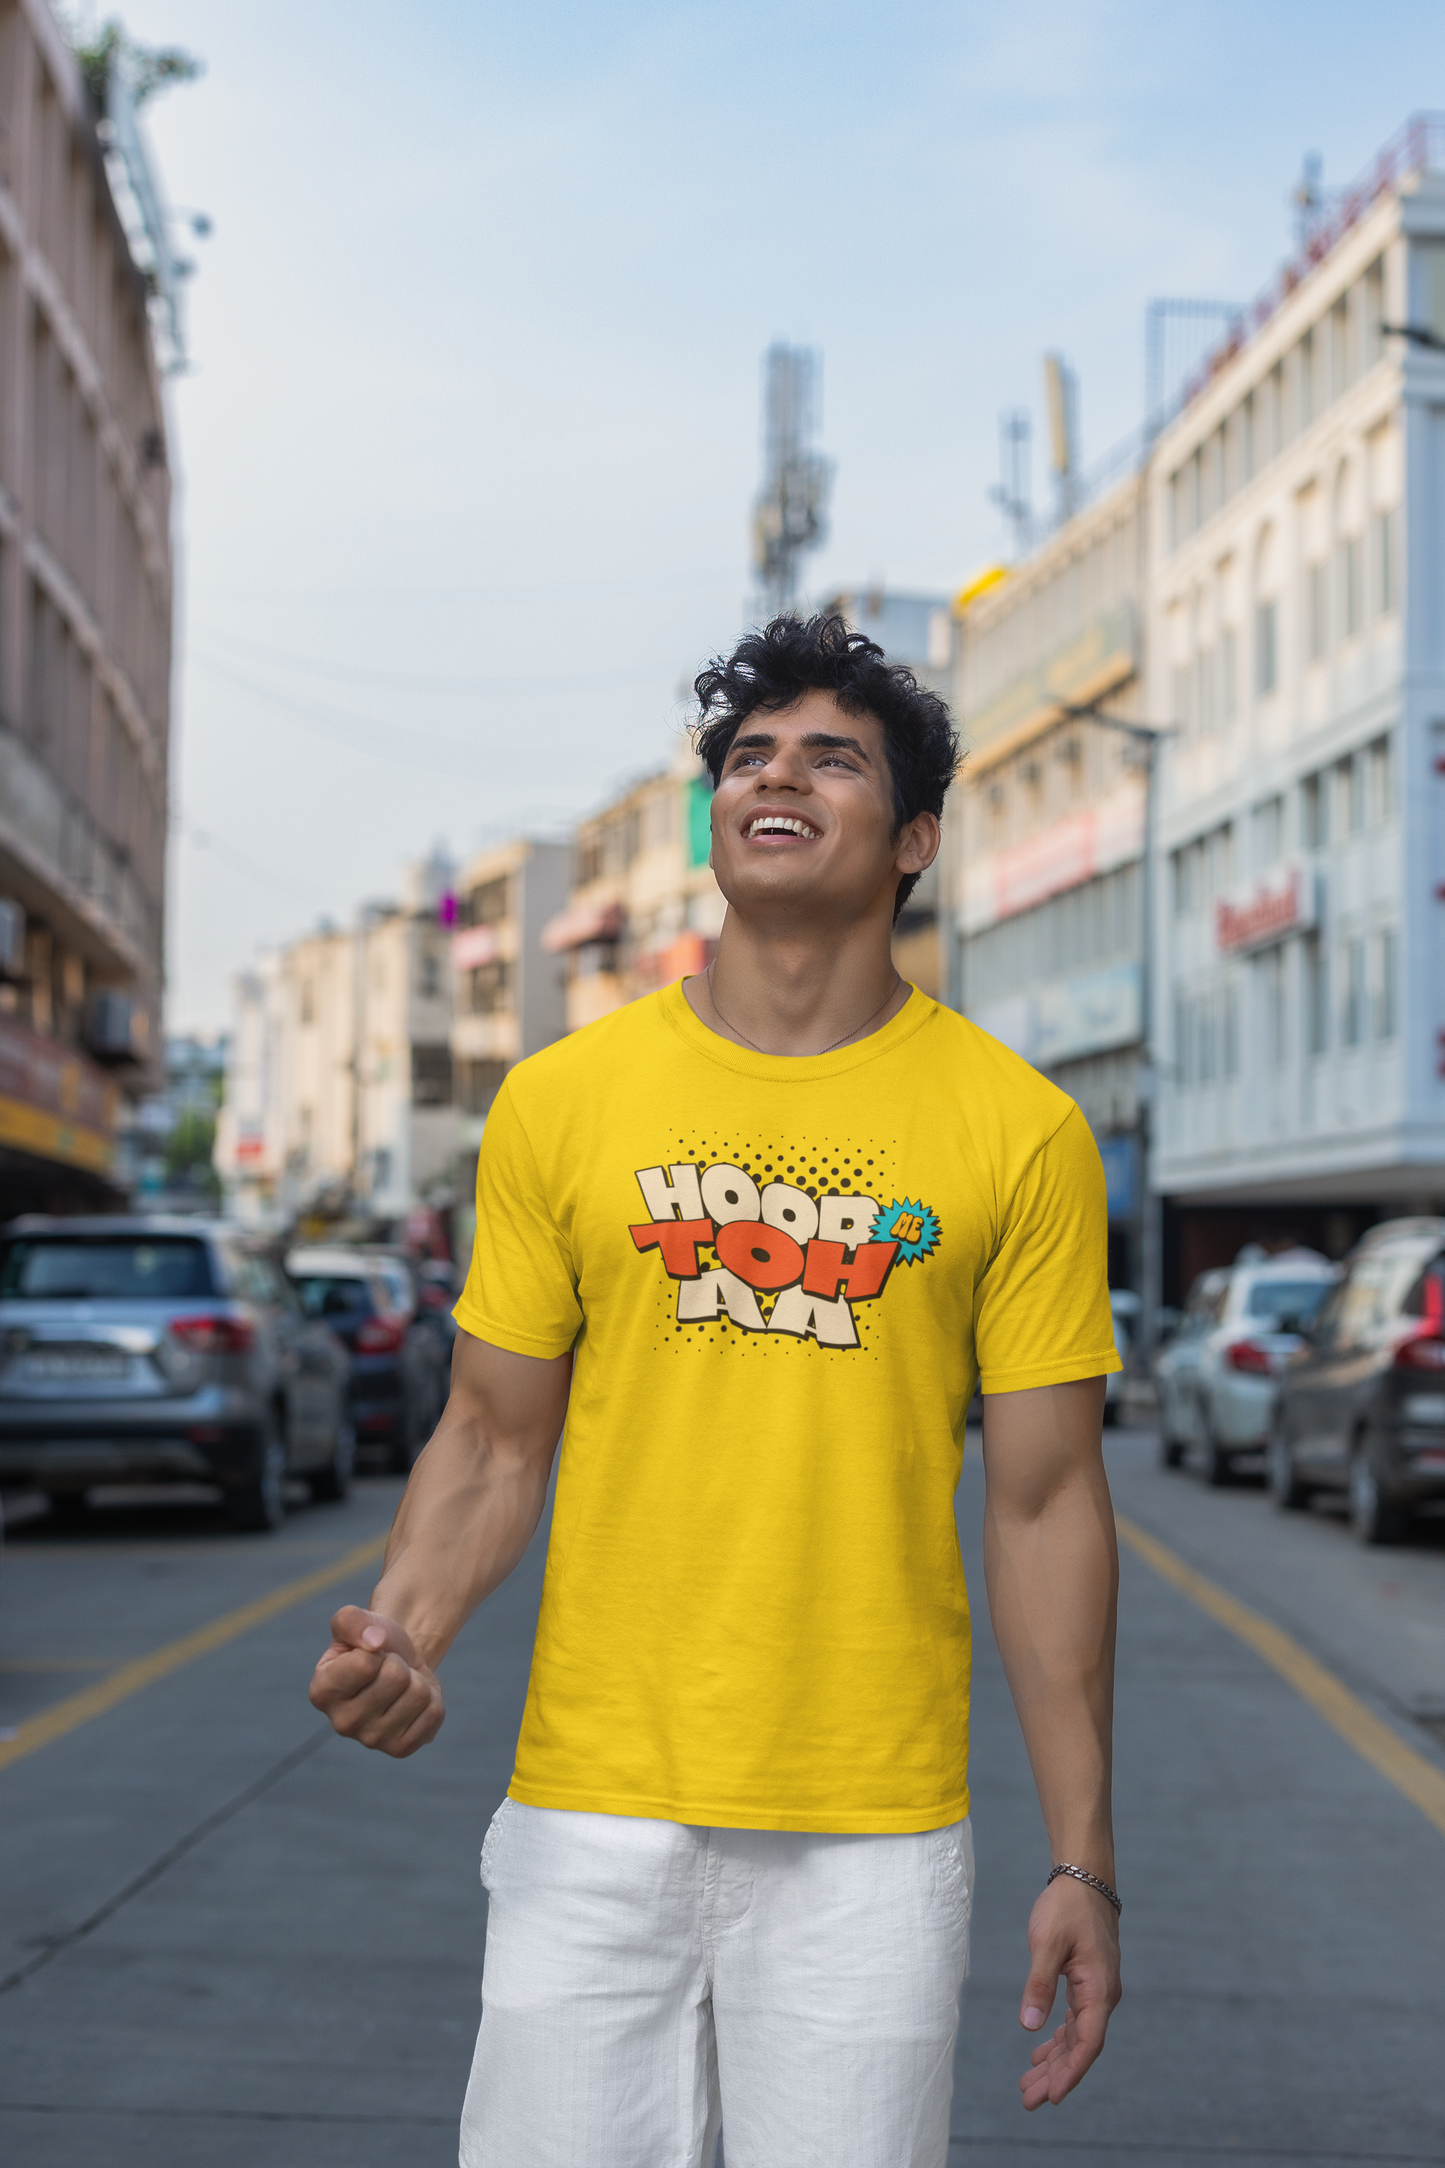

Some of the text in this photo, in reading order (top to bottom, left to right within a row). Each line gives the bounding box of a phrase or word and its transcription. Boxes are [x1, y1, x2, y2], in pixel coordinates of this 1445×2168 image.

[628, 1217, 901, 1303] TOH
[890, 1211, 924, 1246] ME
[676, 1267, 862, 1349] AA
